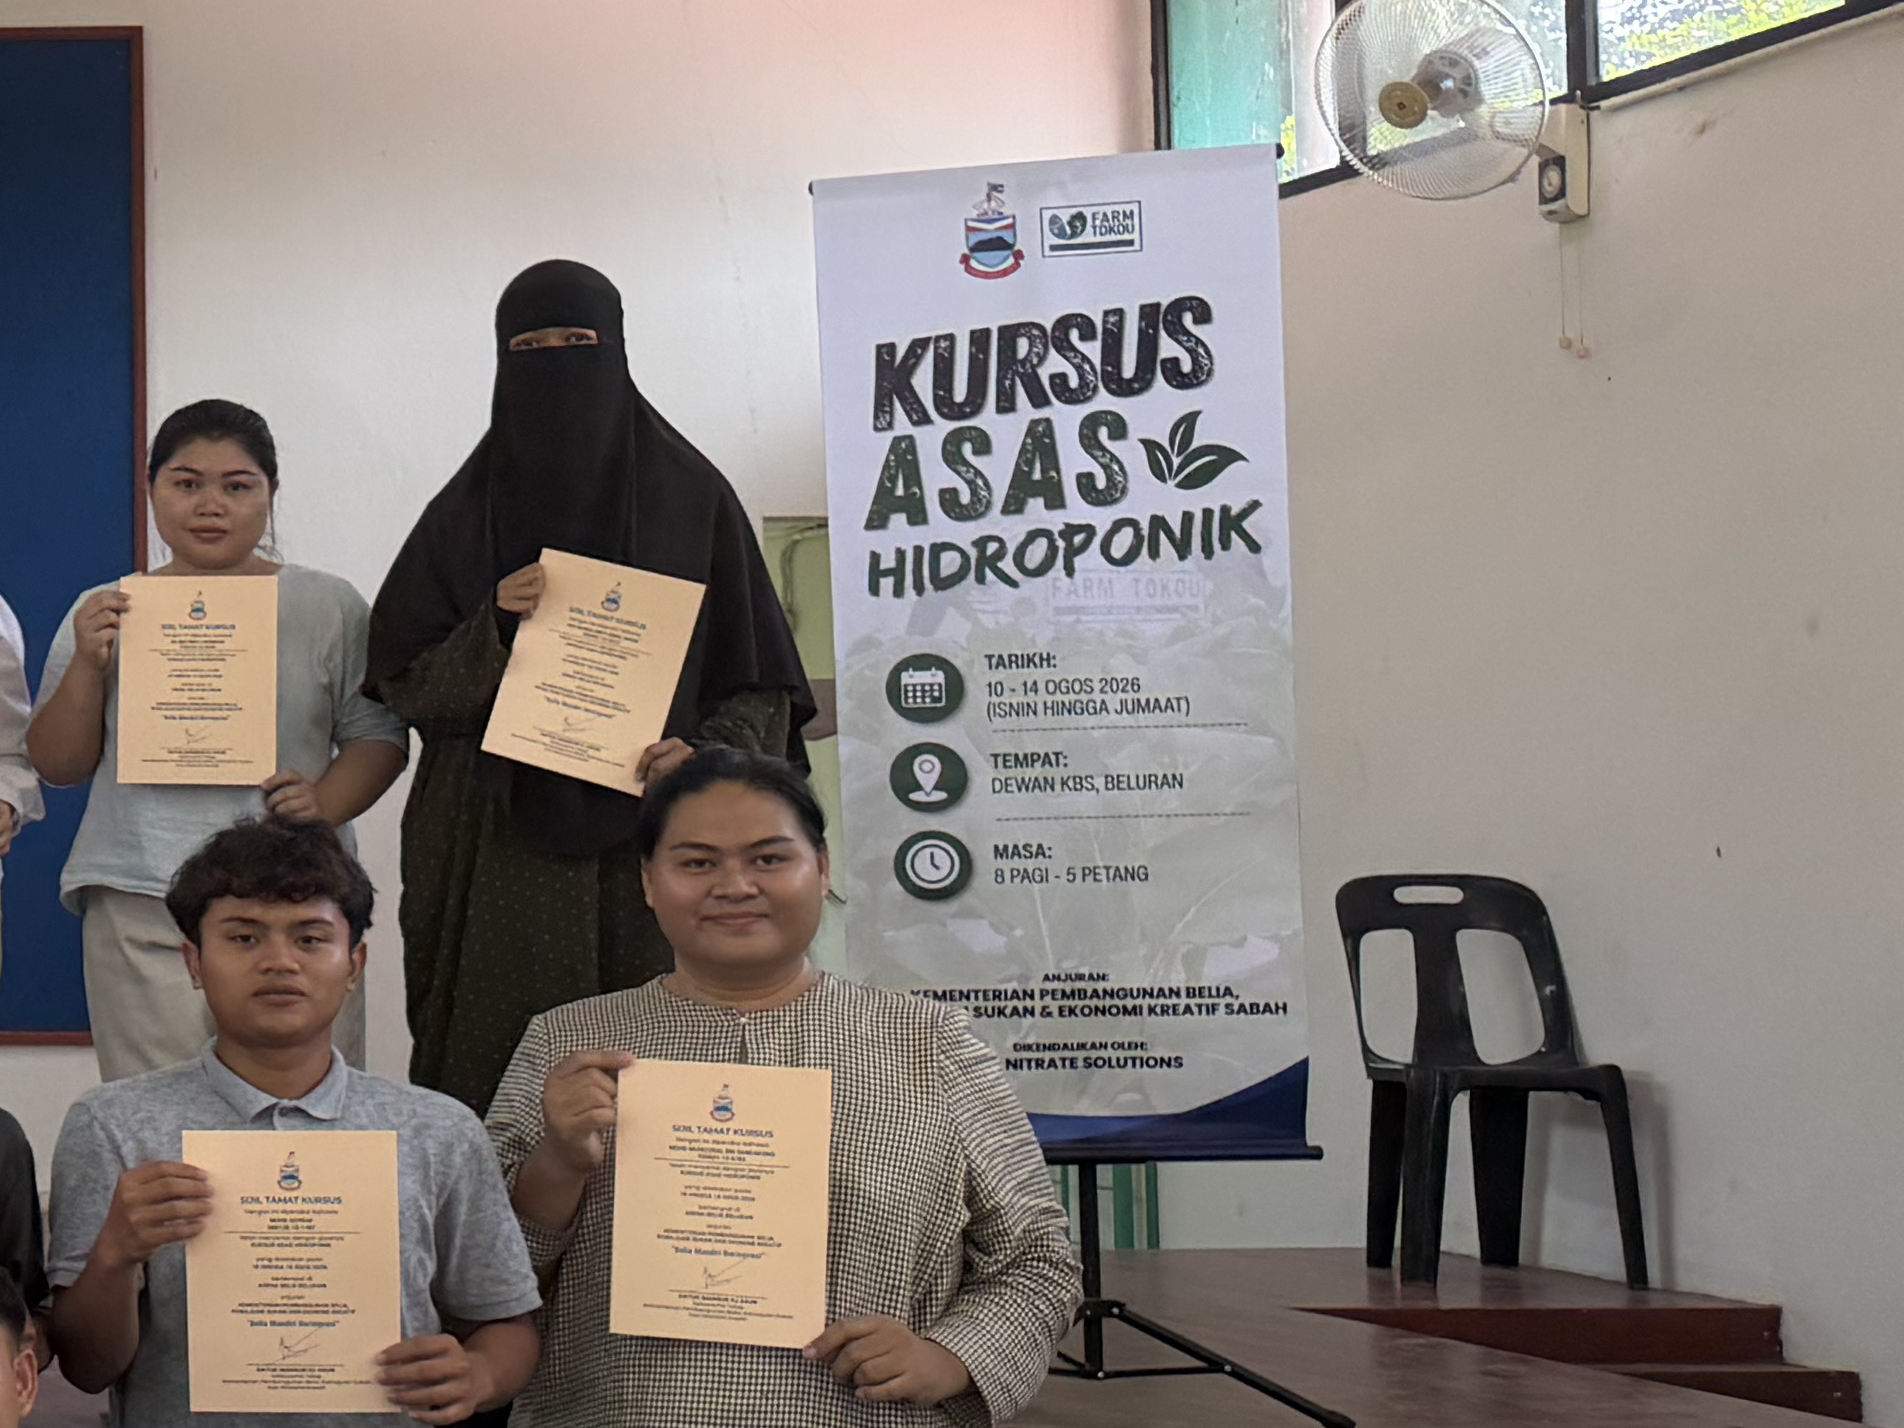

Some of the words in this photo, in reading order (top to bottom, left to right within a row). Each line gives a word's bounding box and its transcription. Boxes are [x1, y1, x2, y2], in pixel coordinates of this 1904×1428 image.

[1091, 208, 1134, 224] FARM
[1090, 223, 1135, 238] TOKOU
[873, 295, 1214, 432] KURSUS
[864, 410, 1129, 531] ASAS
[867, 499, 1263, 599] HIDROPONIK
[984, 652, 1057, 670] TARIKH:
[987, 681, 1004, 697] 10
[1022, 680, 1039, 696] 14
[1044, 678, 1094, 695] OGOS
[1099, 677, 1141, 693] 2026
[987, 701, 1038, 722] (ISNIN
[1043, 699, 1110, 717] HINGGA
[1114, 696, 1190, 717] JUMAAT)
[990, 751, 1068, 769] TEMPAT:
[992, 777, 1055, 794] DEWAN
[1060, 775, 1100, 795] KBS,
[1104, 773, 1184, 792] BELURAN
[993, 843, 1053, 860] MASA:
[994, 868, 1005, 884] 8
[1010, 867, 1049, 884] PAGI
[1066, 867, 1076, 883] 5
[1081, 865, 1149, 883] PETANG
[1042, 973, 1109, 983] ANJURAN:
[1039, 987, 1181, 1001] PEMBANGUNAN
[1185, 986, 1240, 1001] BELIA,
[972, 1005, 1035, 1019] SUKAN
[1040, 1005, 1053, 1018] &
[1058, 1003, 1143, 1017] EKONOMI
[1147, 1003, 1221, 1017] KREATIF
[1224, 1001, 1288, 1016] SABAH
[1013, 1041, 1109, 1053] DIKENDALIKAN
[1110, 1041, 1148, 1052] OLEH:
[1006, 1056, 1079, 1070] NITRATE
[1083, 1055, 1184, 1070] SOLUTIONS
